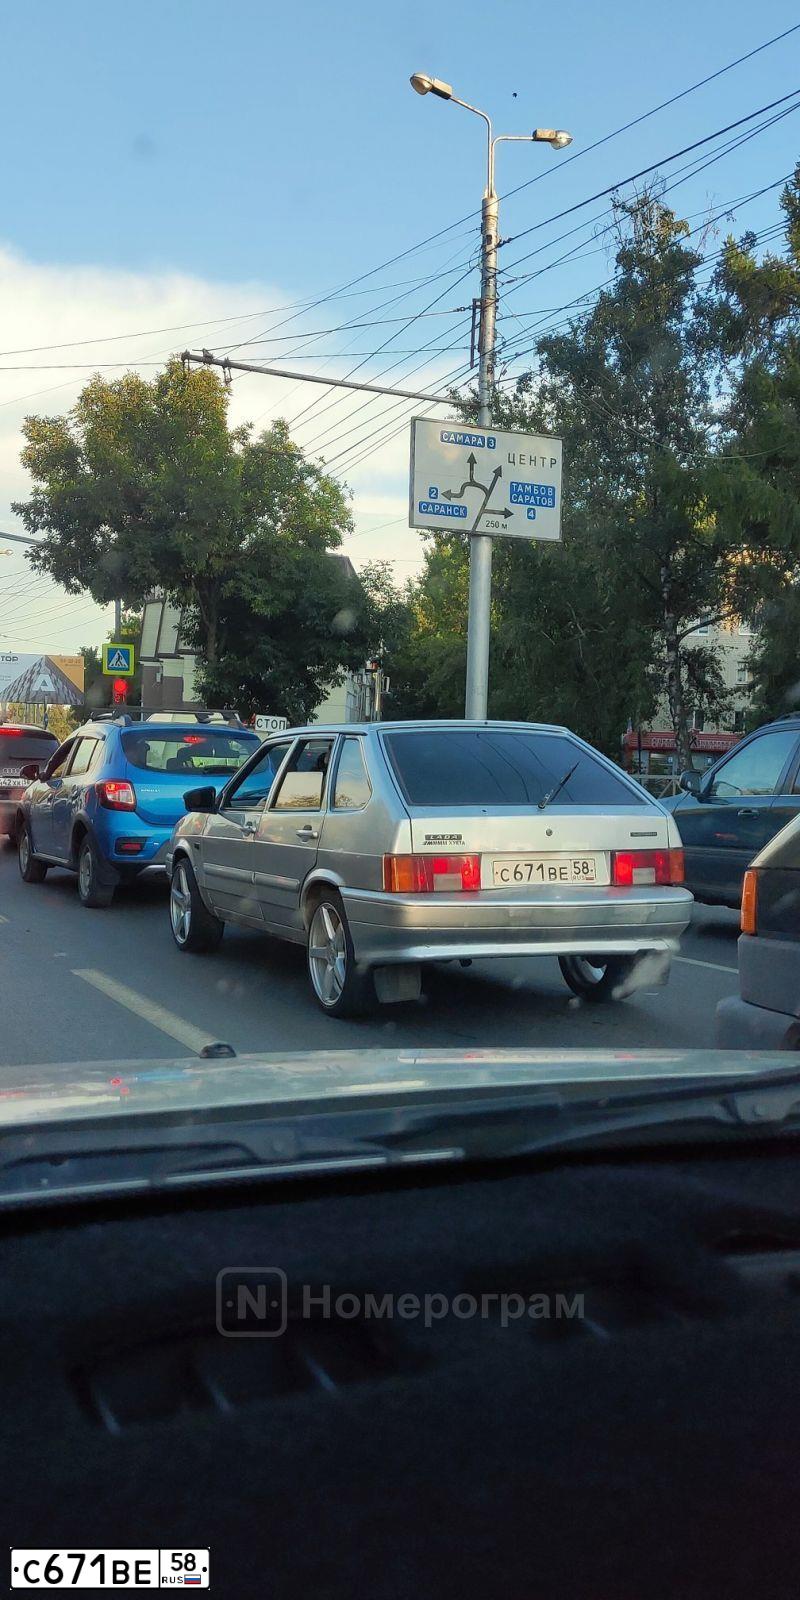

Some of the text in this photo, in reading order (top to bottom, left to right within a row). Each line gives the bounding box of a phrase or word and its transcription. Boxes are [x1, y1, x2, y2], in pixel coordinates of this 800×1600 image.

[442, 432, 495, 448] САМАРА 3
[507, 453, 557, 469] ЦЕНТР
[430, 488, 437, 498] 2
[512, 483, 553, 496] ТАМБОВ
[511, 494, 553, 506] САРАТОВ
[421, 502, 466, 517] САРАНСК
[528, 509, 535, 518] 4
[485, 520, 500, 529] 250
[256, 718, 286, 730] СТОП
[500, 861, 589, 882] С671ВЕ 58
